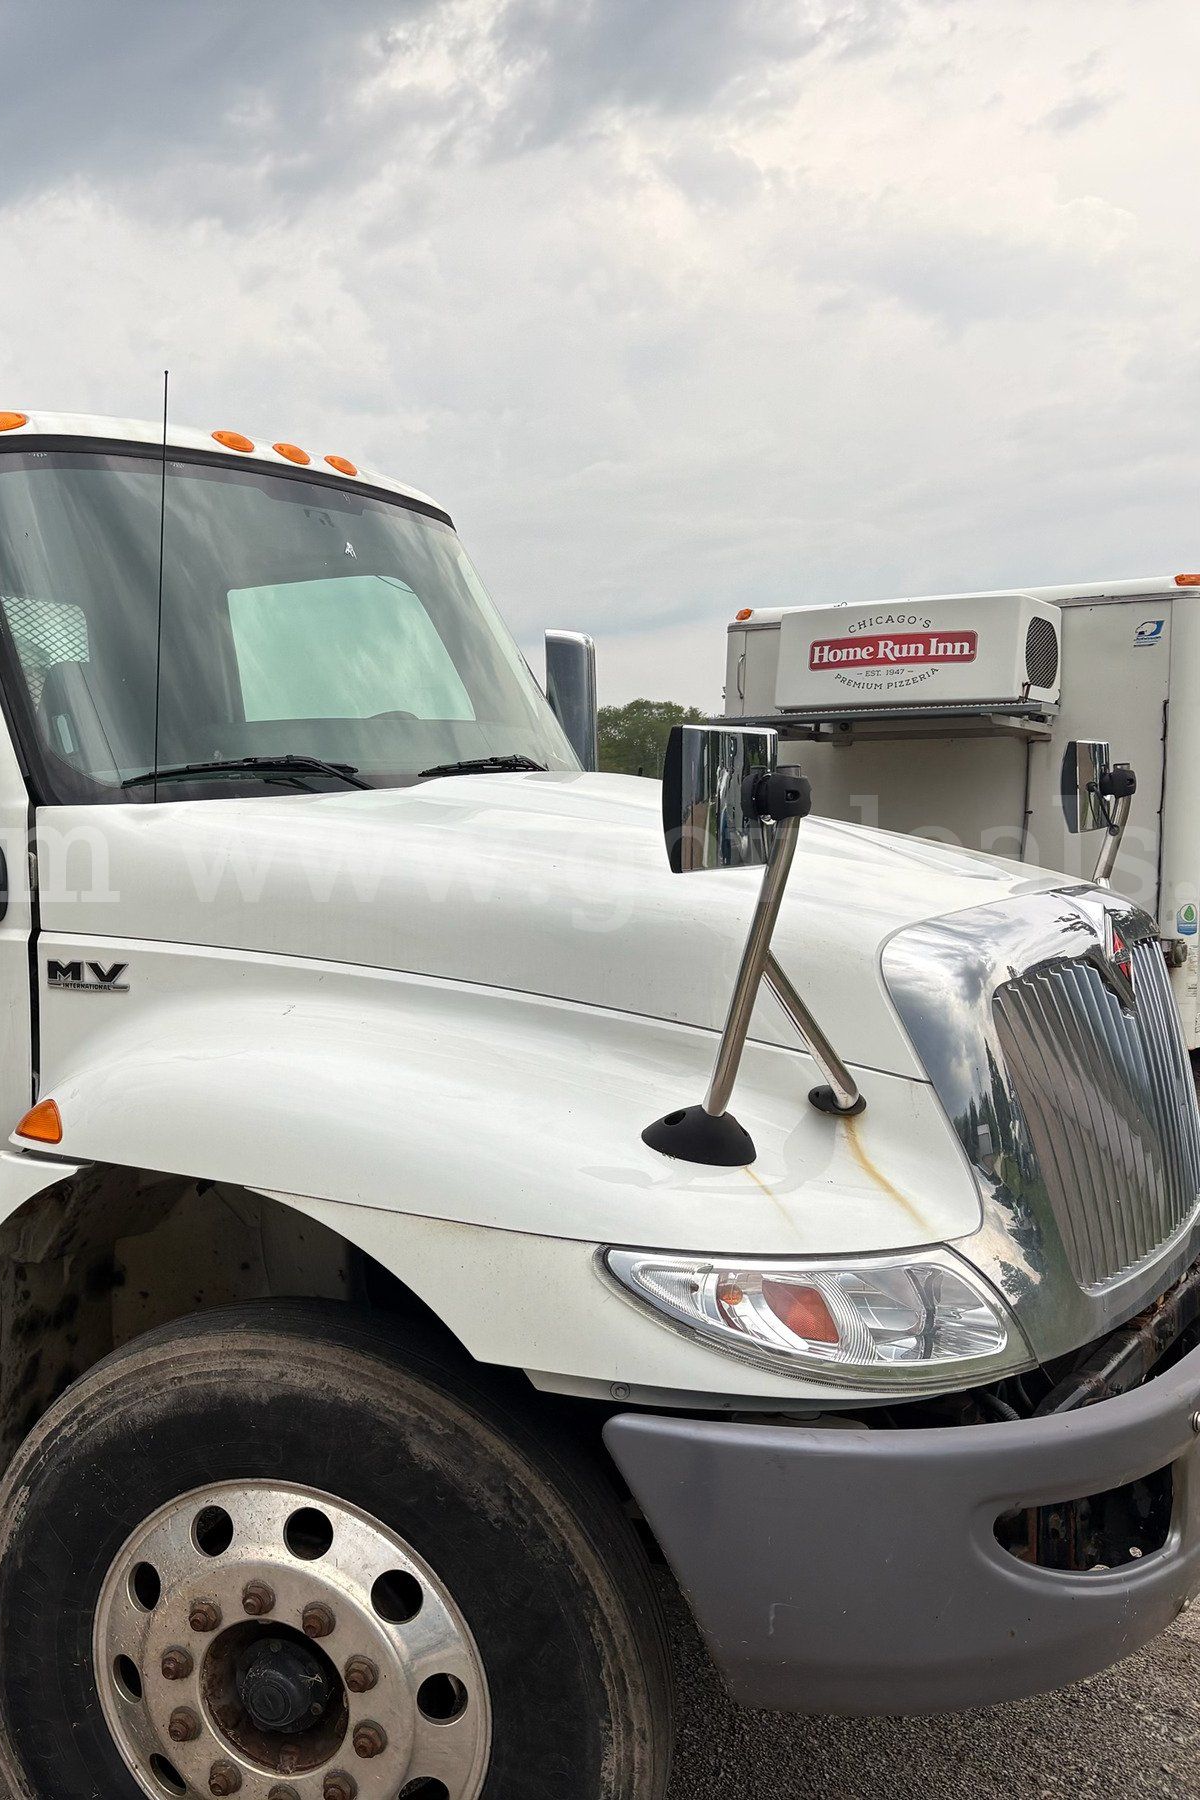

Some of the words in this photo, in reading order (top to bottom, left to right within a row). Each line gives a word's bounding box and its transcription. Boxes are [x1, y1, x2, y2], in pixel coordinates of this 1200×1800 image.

[848, 614, 932, 634] CHICAGO'S
[812, 645, 875, 664] Home
[877, 640, 925, 661] Run
[834, 673, 883, 690] PREMIUM
[886, 667, 940, 690] PIZZERIA
[885, 668, 905, 676] 1947
[47, 959, 130, 984] MV
[62, 982, 111, 990] INTERNATIONAL
